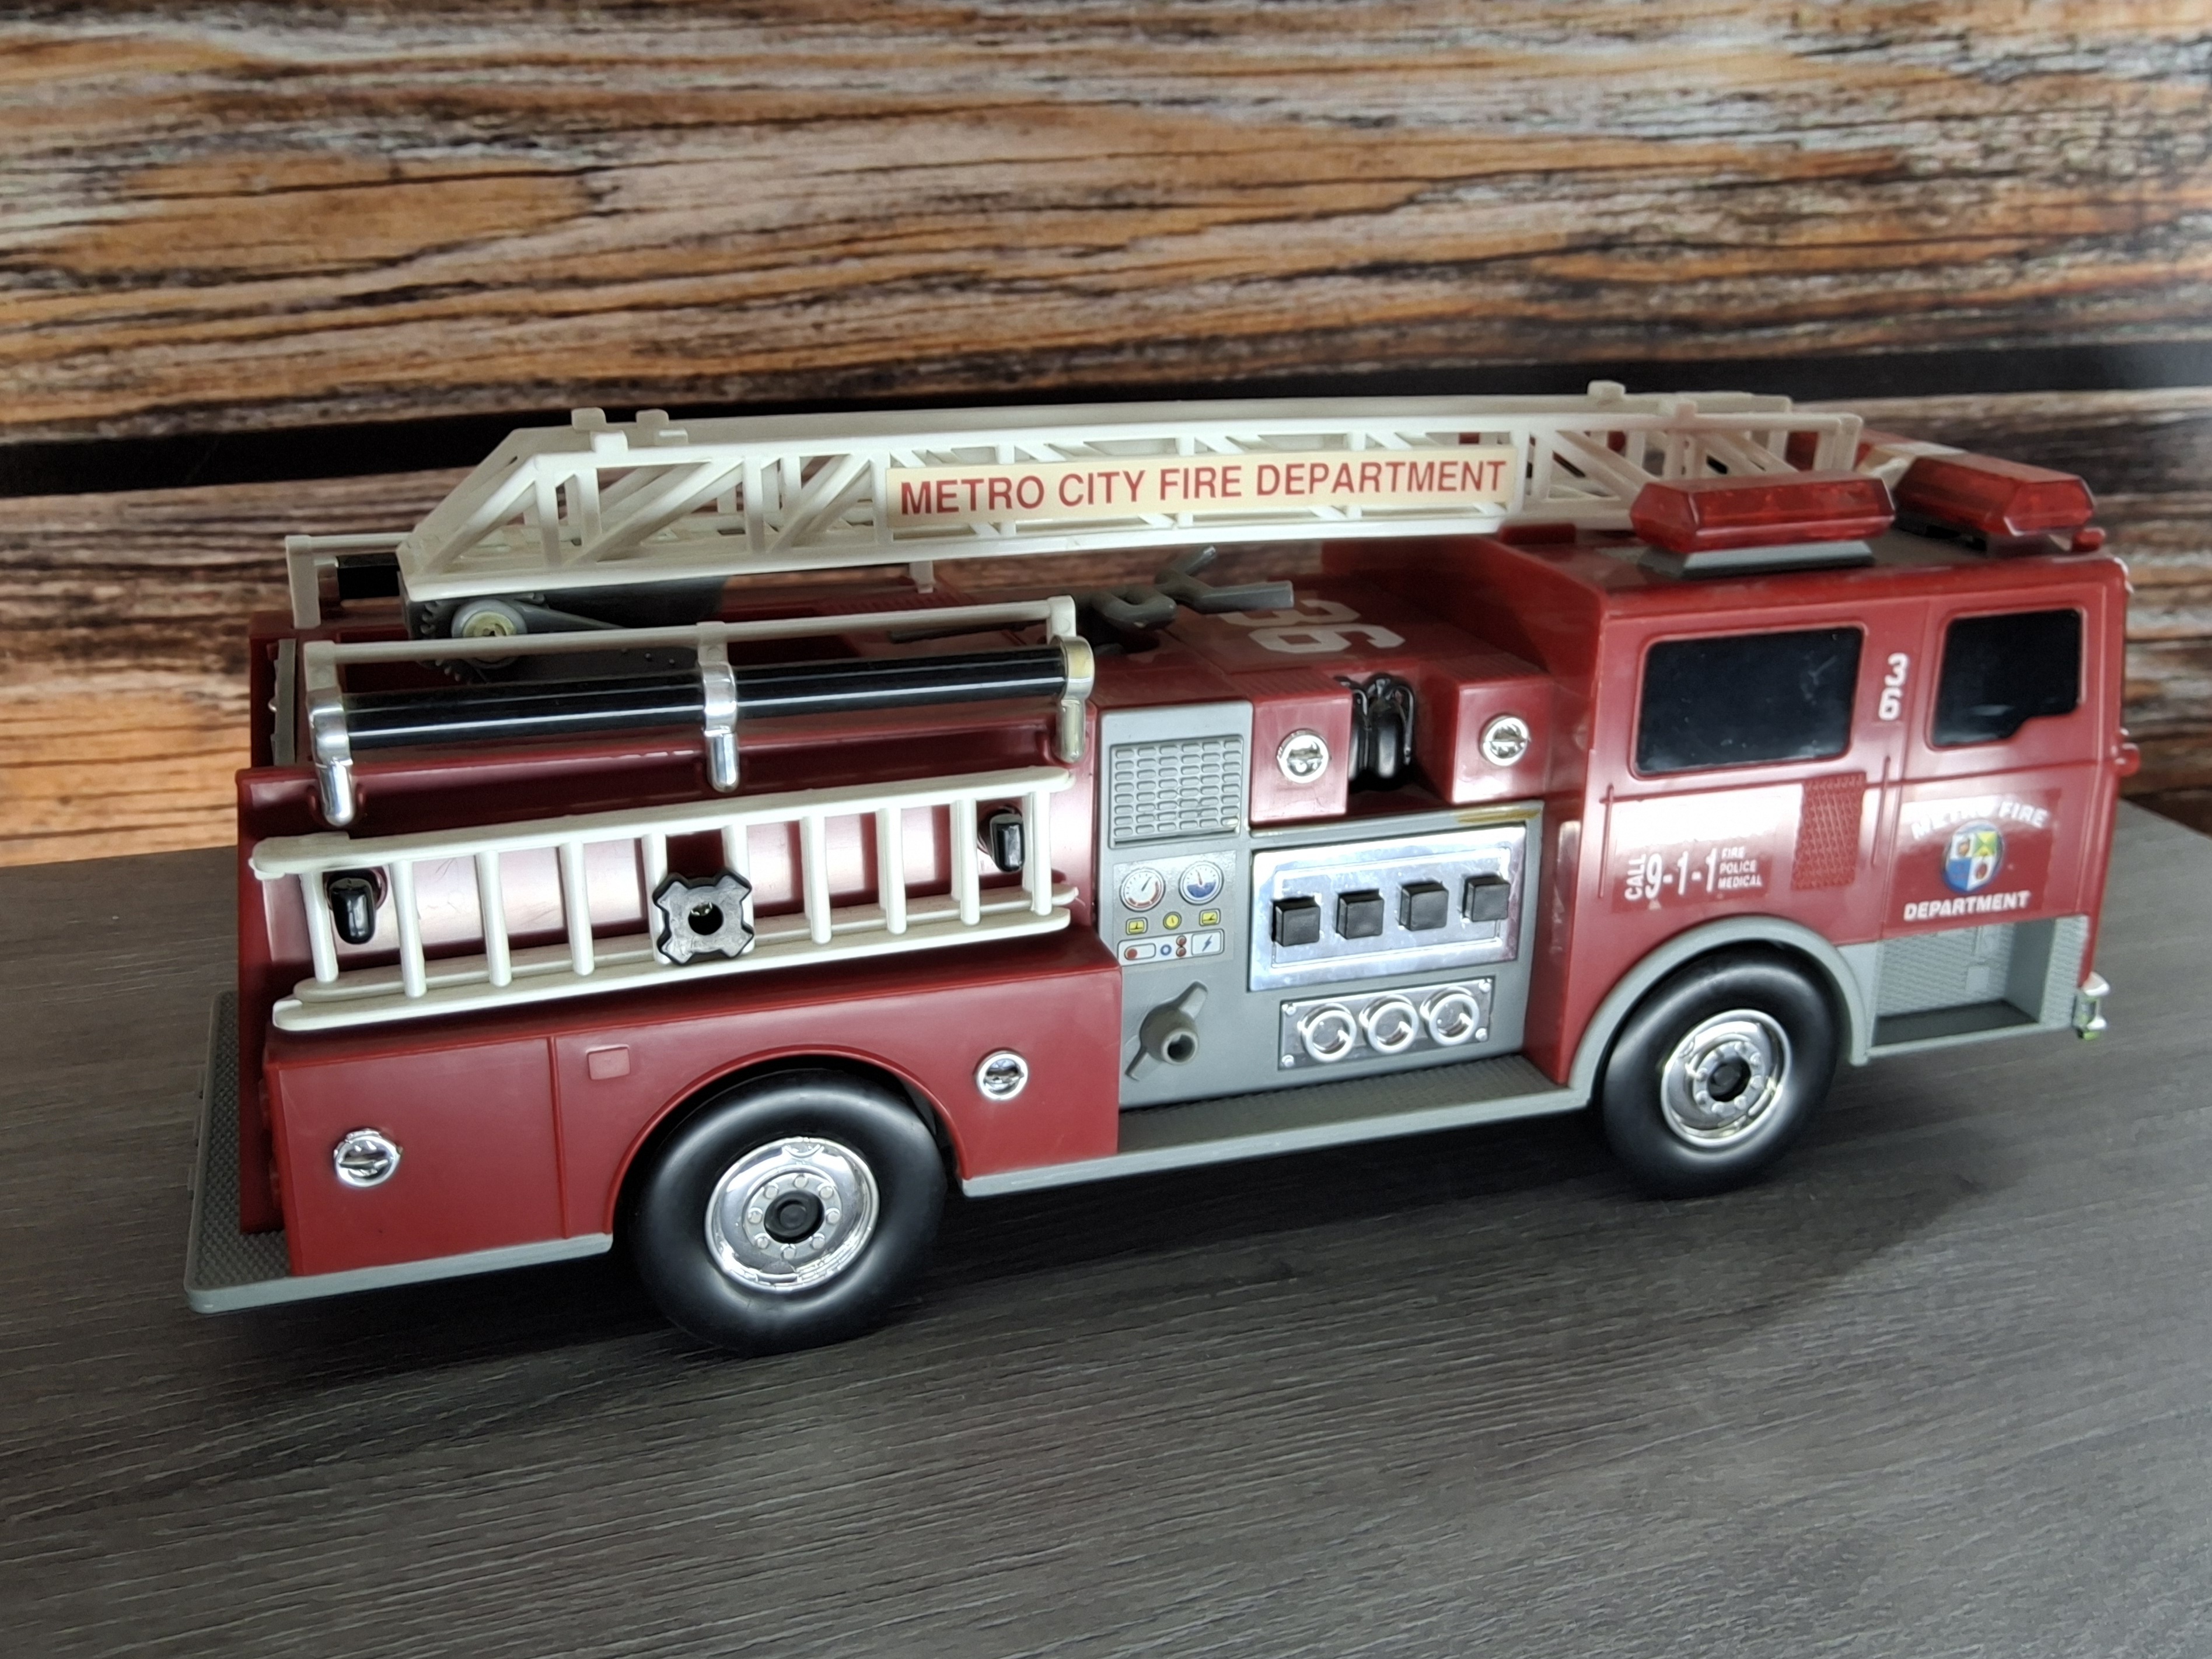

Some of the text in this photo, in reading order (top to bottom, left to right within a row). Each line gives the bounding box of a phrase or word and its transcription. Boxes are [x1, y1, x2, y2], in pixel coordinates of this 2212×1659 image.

[901, 460, 1507, 515] METRO CITY FIRE DEPARTMENT
[1878, 652, 1909, 721] 36
[1999, 800, 2049, 828] FIRE
[1720, 860, 1757, 874] POLICE
[1721, 846, 1745, 859] FIRE
[1624, 853, 1647, 901] CALL
[1645, 848, 1718, 899] 9-1-1
[1718, 874, 1763, 890] MEDICAL
[1903, 890, 2031, 922] DEPARTMENT
